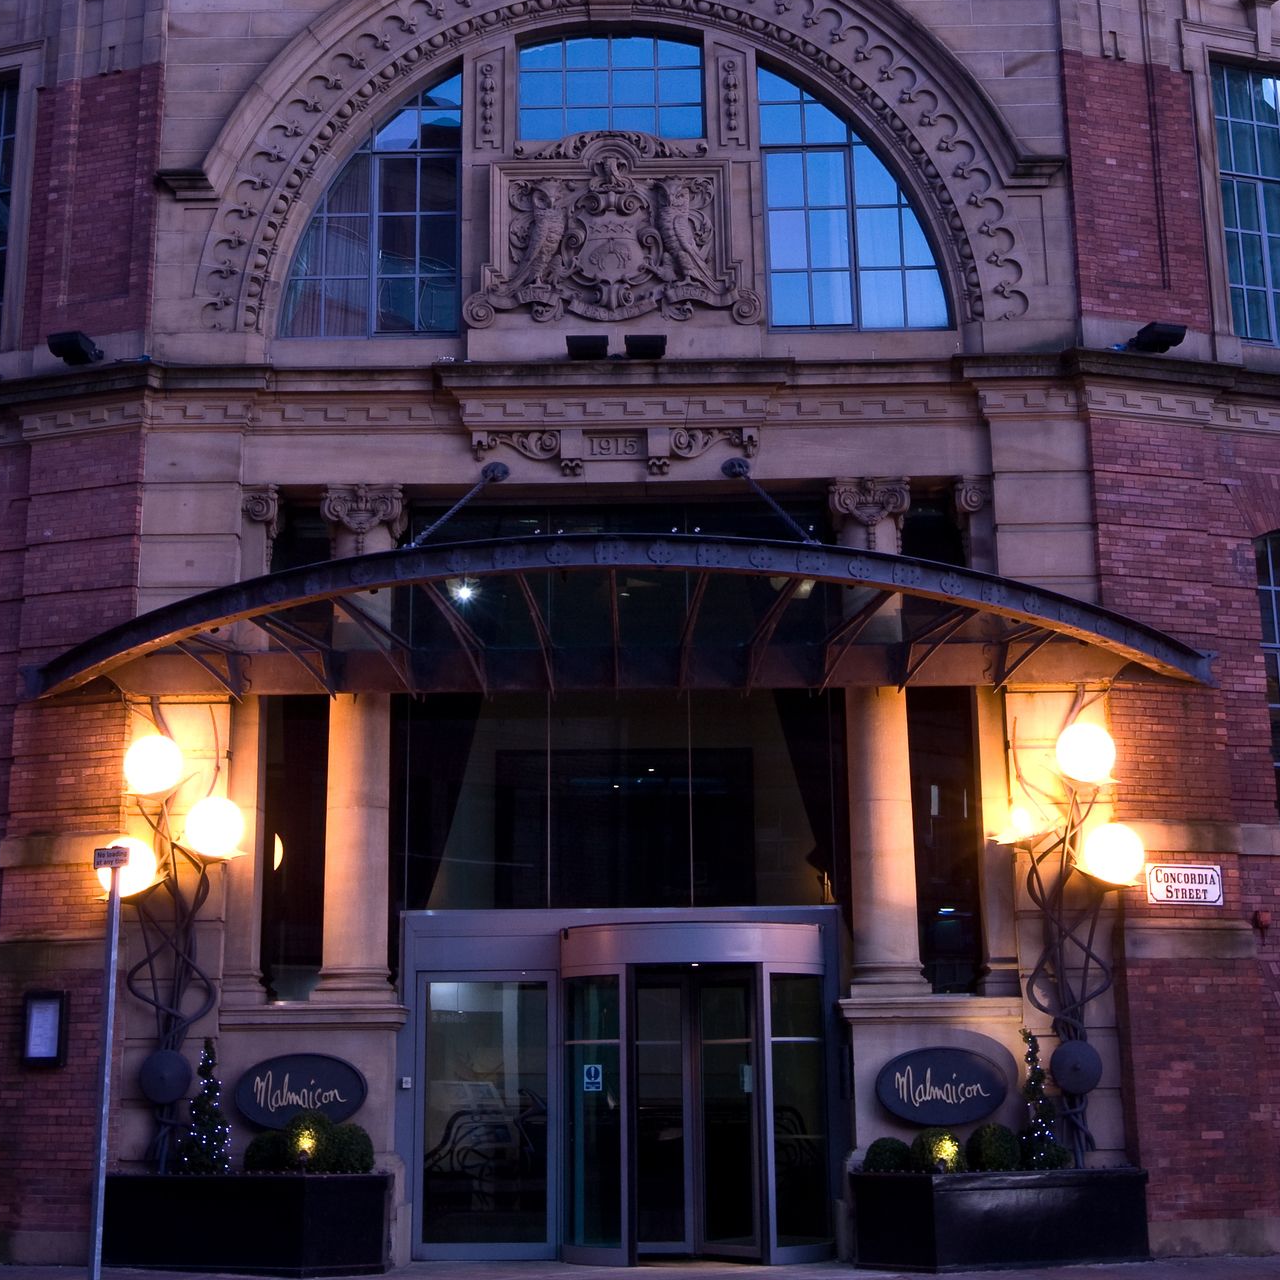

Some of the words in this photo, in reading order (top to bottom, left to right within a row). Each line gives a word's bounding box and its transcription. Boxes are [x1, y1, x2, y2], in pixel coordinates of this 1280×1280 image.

[590, 437, 638, 456] 1915
[1155, 868, 1216, 885] CONCORDIA
[1166, 885, 1209, 900] STREET
[254, 1070, 348, 1112] Malmaison
[895, 1065, 991, 1107] Malmaison
